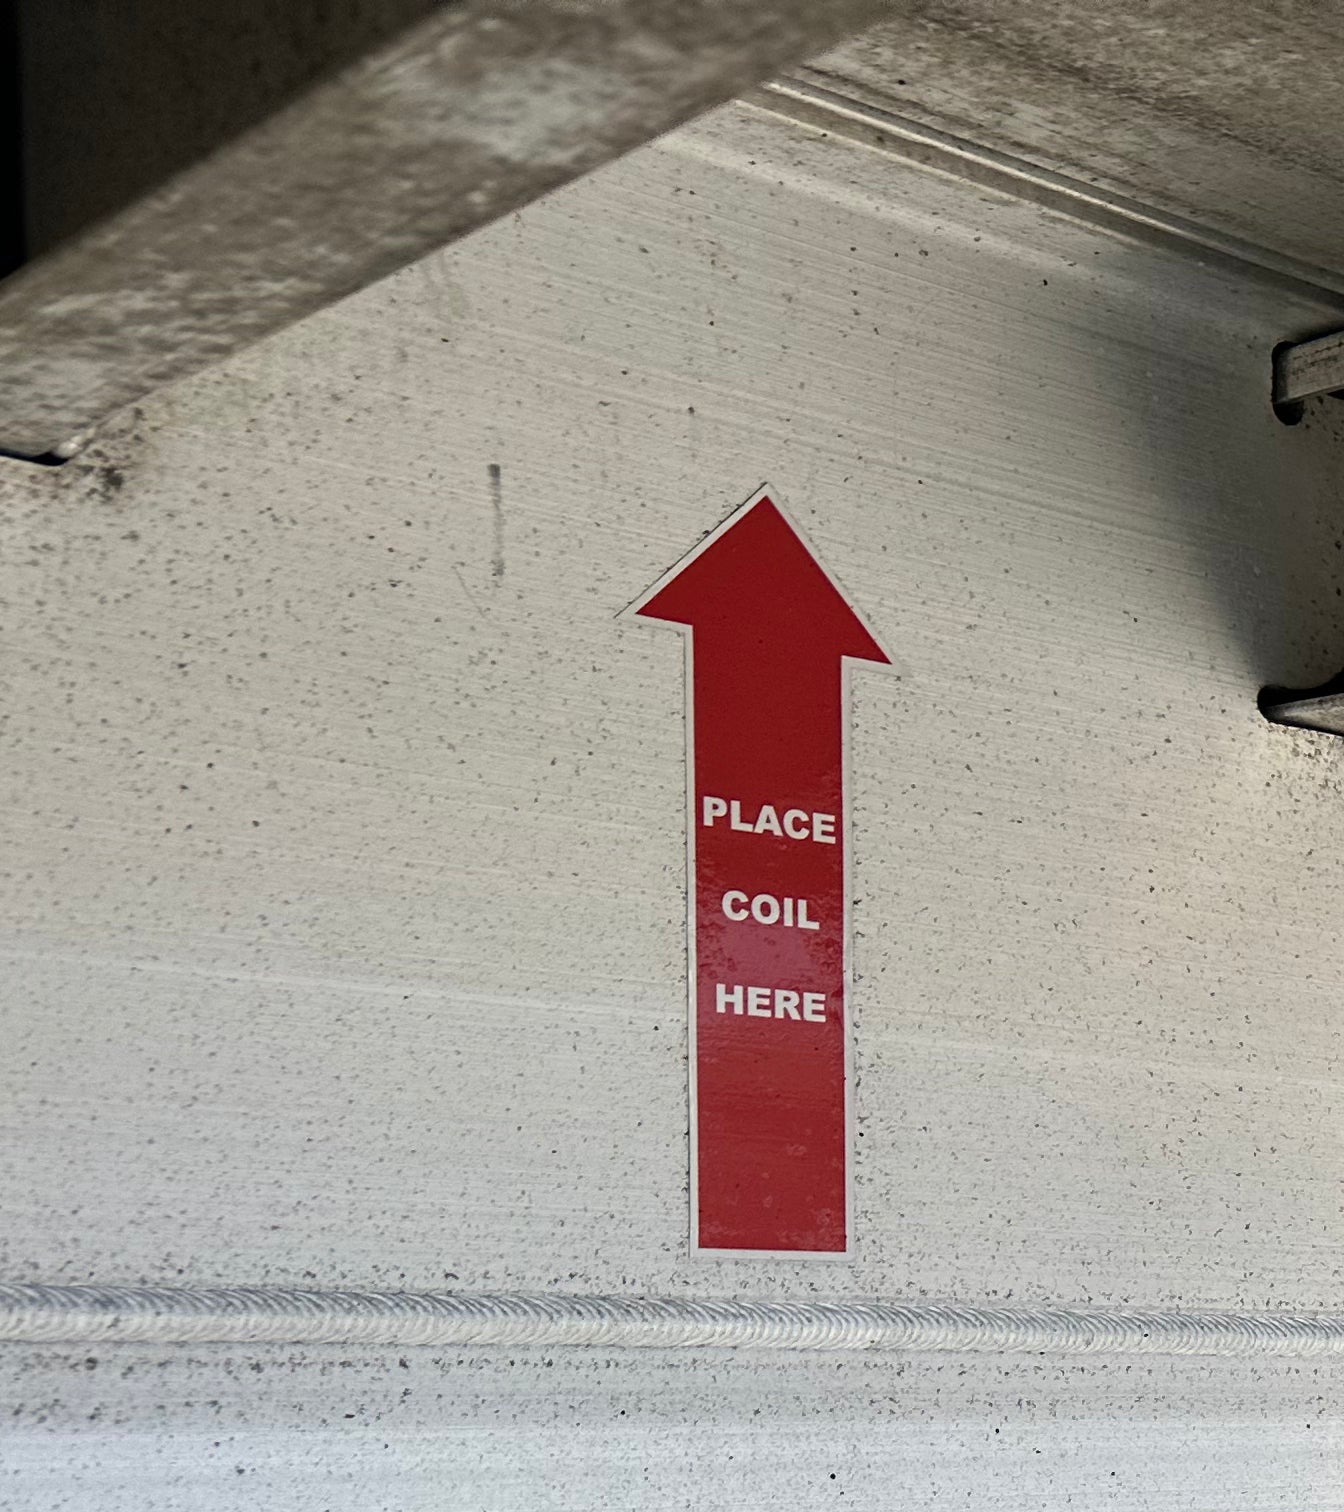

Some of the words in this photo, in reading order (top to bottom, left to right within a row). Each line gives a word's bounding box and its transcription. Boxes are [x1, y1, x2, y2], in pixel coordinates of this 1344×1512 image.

[703, 796, 836, 844] PLACE
[721, 890, 820, 930] COIL
[715, 983, 826, 1023] HERE
